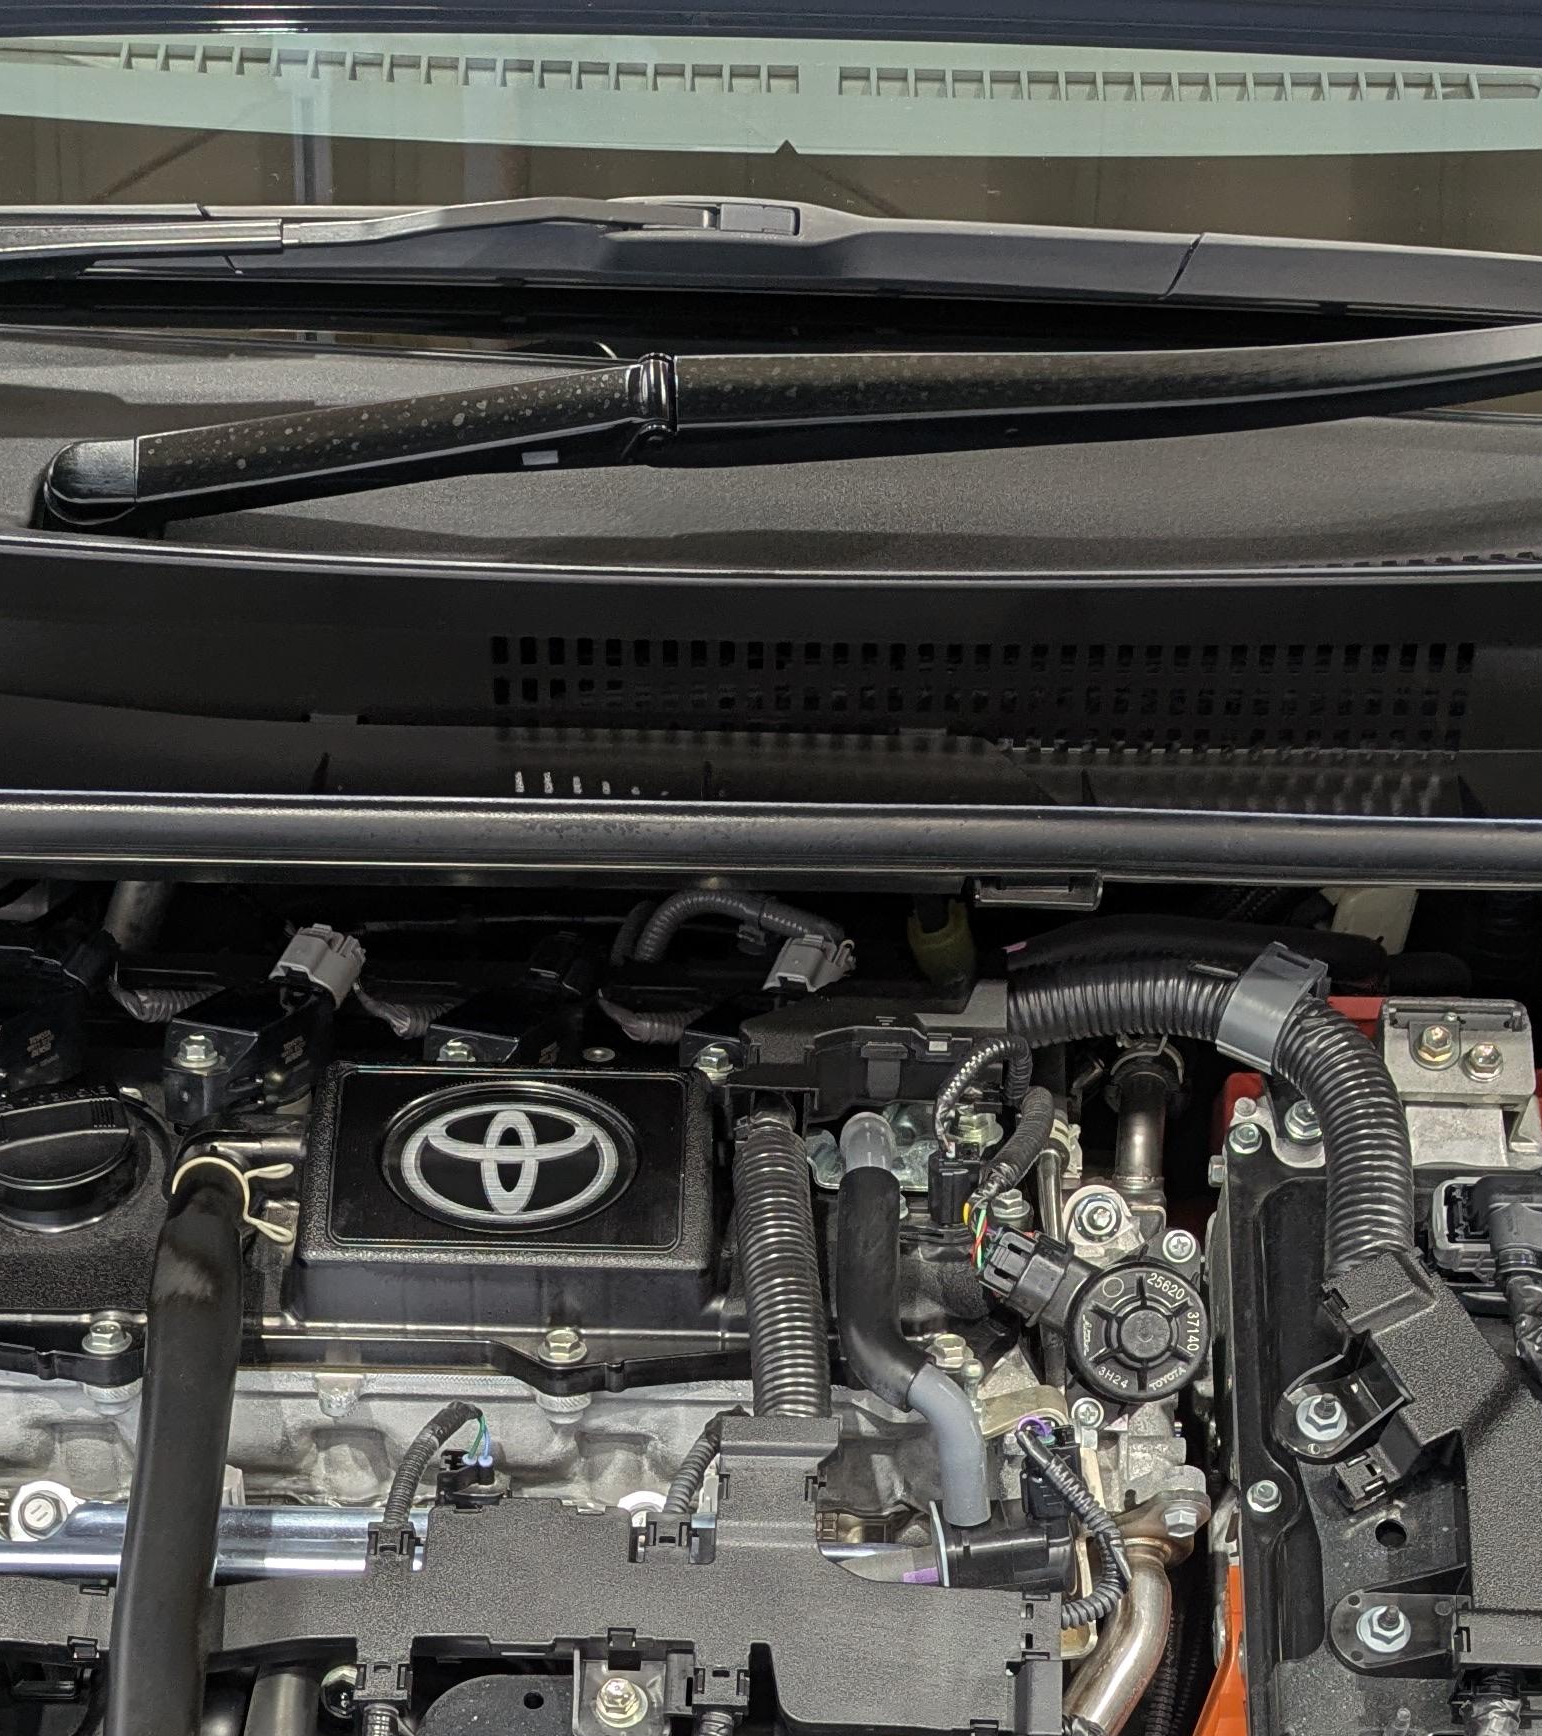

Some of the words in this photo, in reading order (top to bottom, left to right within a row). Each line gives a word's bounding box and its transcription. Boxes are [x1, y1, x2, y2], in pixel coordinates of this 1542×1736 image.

[1147, 1272, 1185, 1300] 25620
[1186, 1311, 1200, 1352] 37140
[1098, 1366, 1129, 1389] 3H24
[1149, 1366, 1187, 1391] TOYOTA
